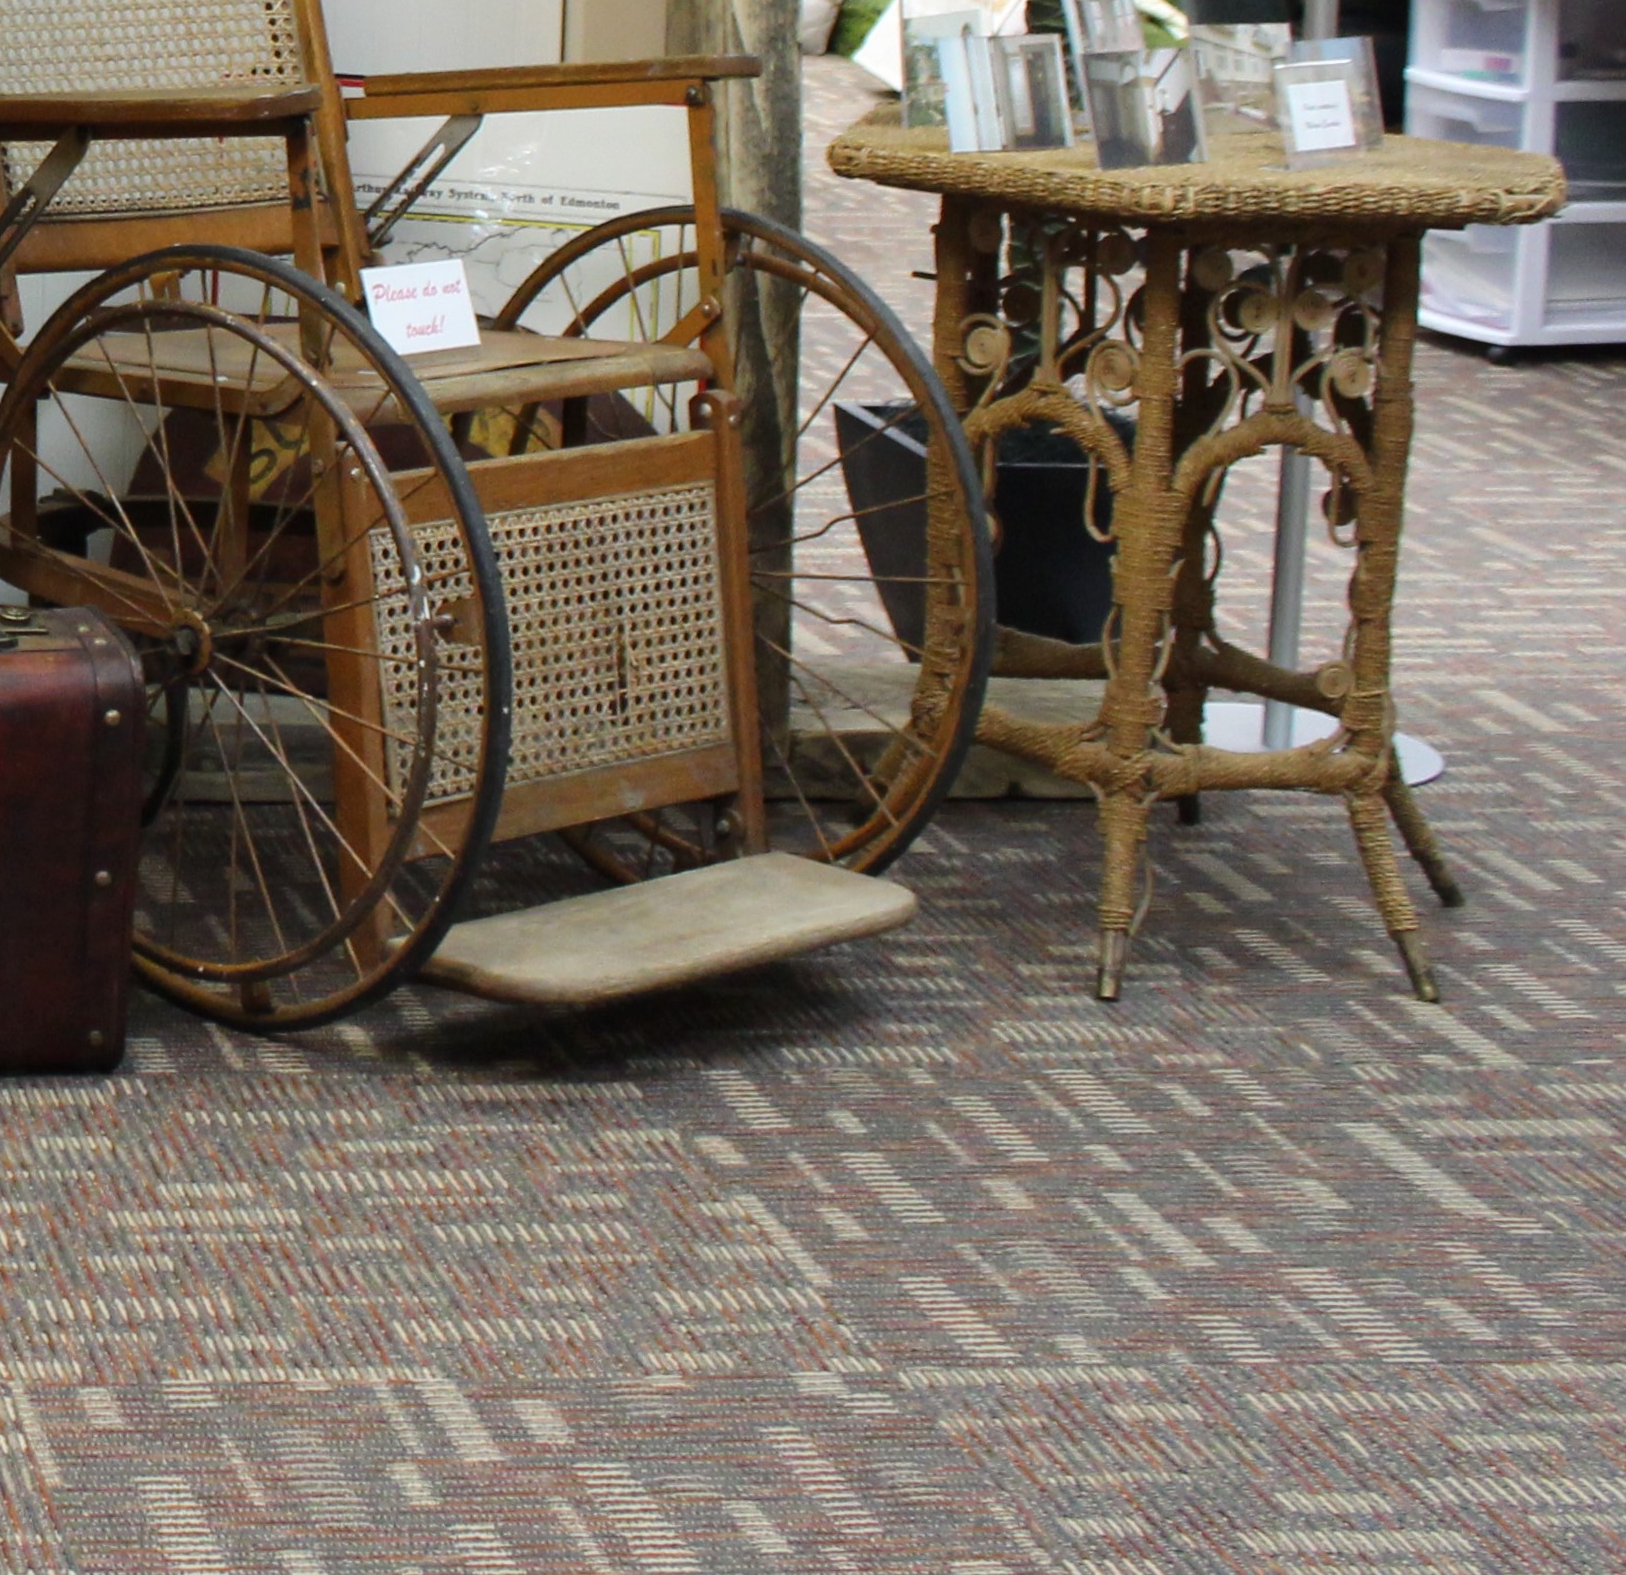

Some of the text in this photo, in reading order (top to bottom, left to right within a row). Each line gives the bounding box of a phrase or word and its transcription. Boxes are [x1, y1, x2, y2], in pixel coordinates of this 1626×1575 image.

[541, 194, 553, 205] of
[560, 195, 620, 210] Edmonton
[372, 278, 461, 304] Please do not
[406, 314, 446, 339] touch!
